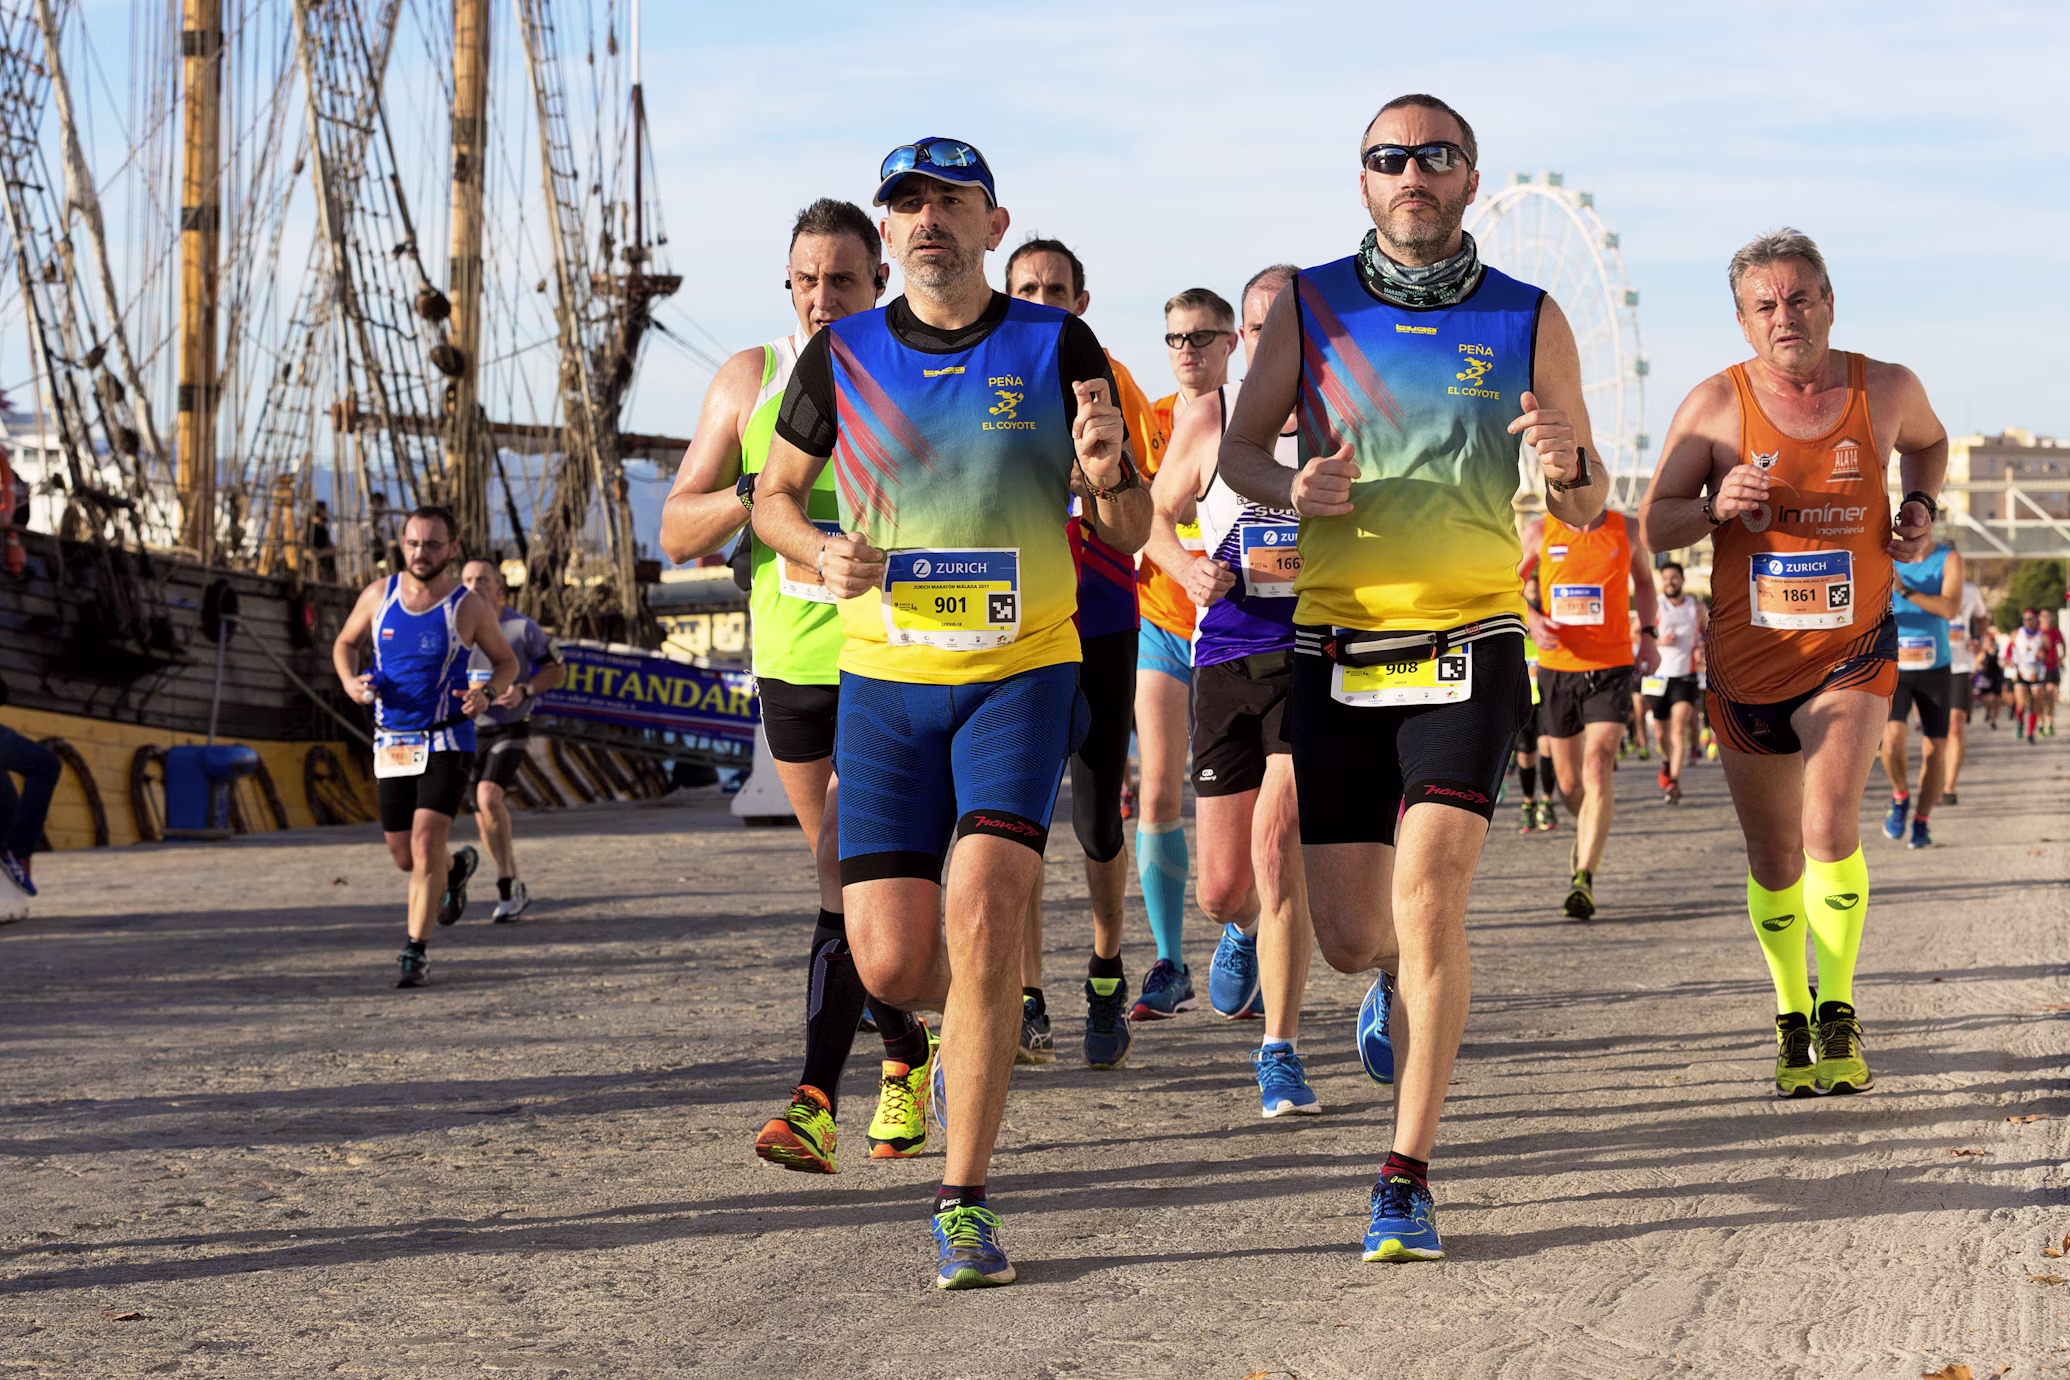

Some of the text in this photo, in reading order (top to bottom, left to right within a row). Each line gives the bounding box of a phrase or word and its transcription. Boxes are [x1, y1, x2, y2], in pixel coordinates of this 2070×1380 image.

[1458, 343, 1494, 357] PEÑA
[988, 374, 1024, 387] PEÑA
[1447, 386, 1500, 400] EL COYOTE
[982, 421, 1036, 431] EL COYOTE
[1778, 503, 1868, 523] inmíner
[936, 562, 987, 574] ZURICH
[1276, 557, 1301, 570] 166
[1786, 562, 1827, 573] ZURICH
[1783, 588, 1816, 601] 1861
[934, 596, 967, 613] 901
[1386, 661, 1418, 676] 908
[554, 661, 760, 717] HTANDAR
